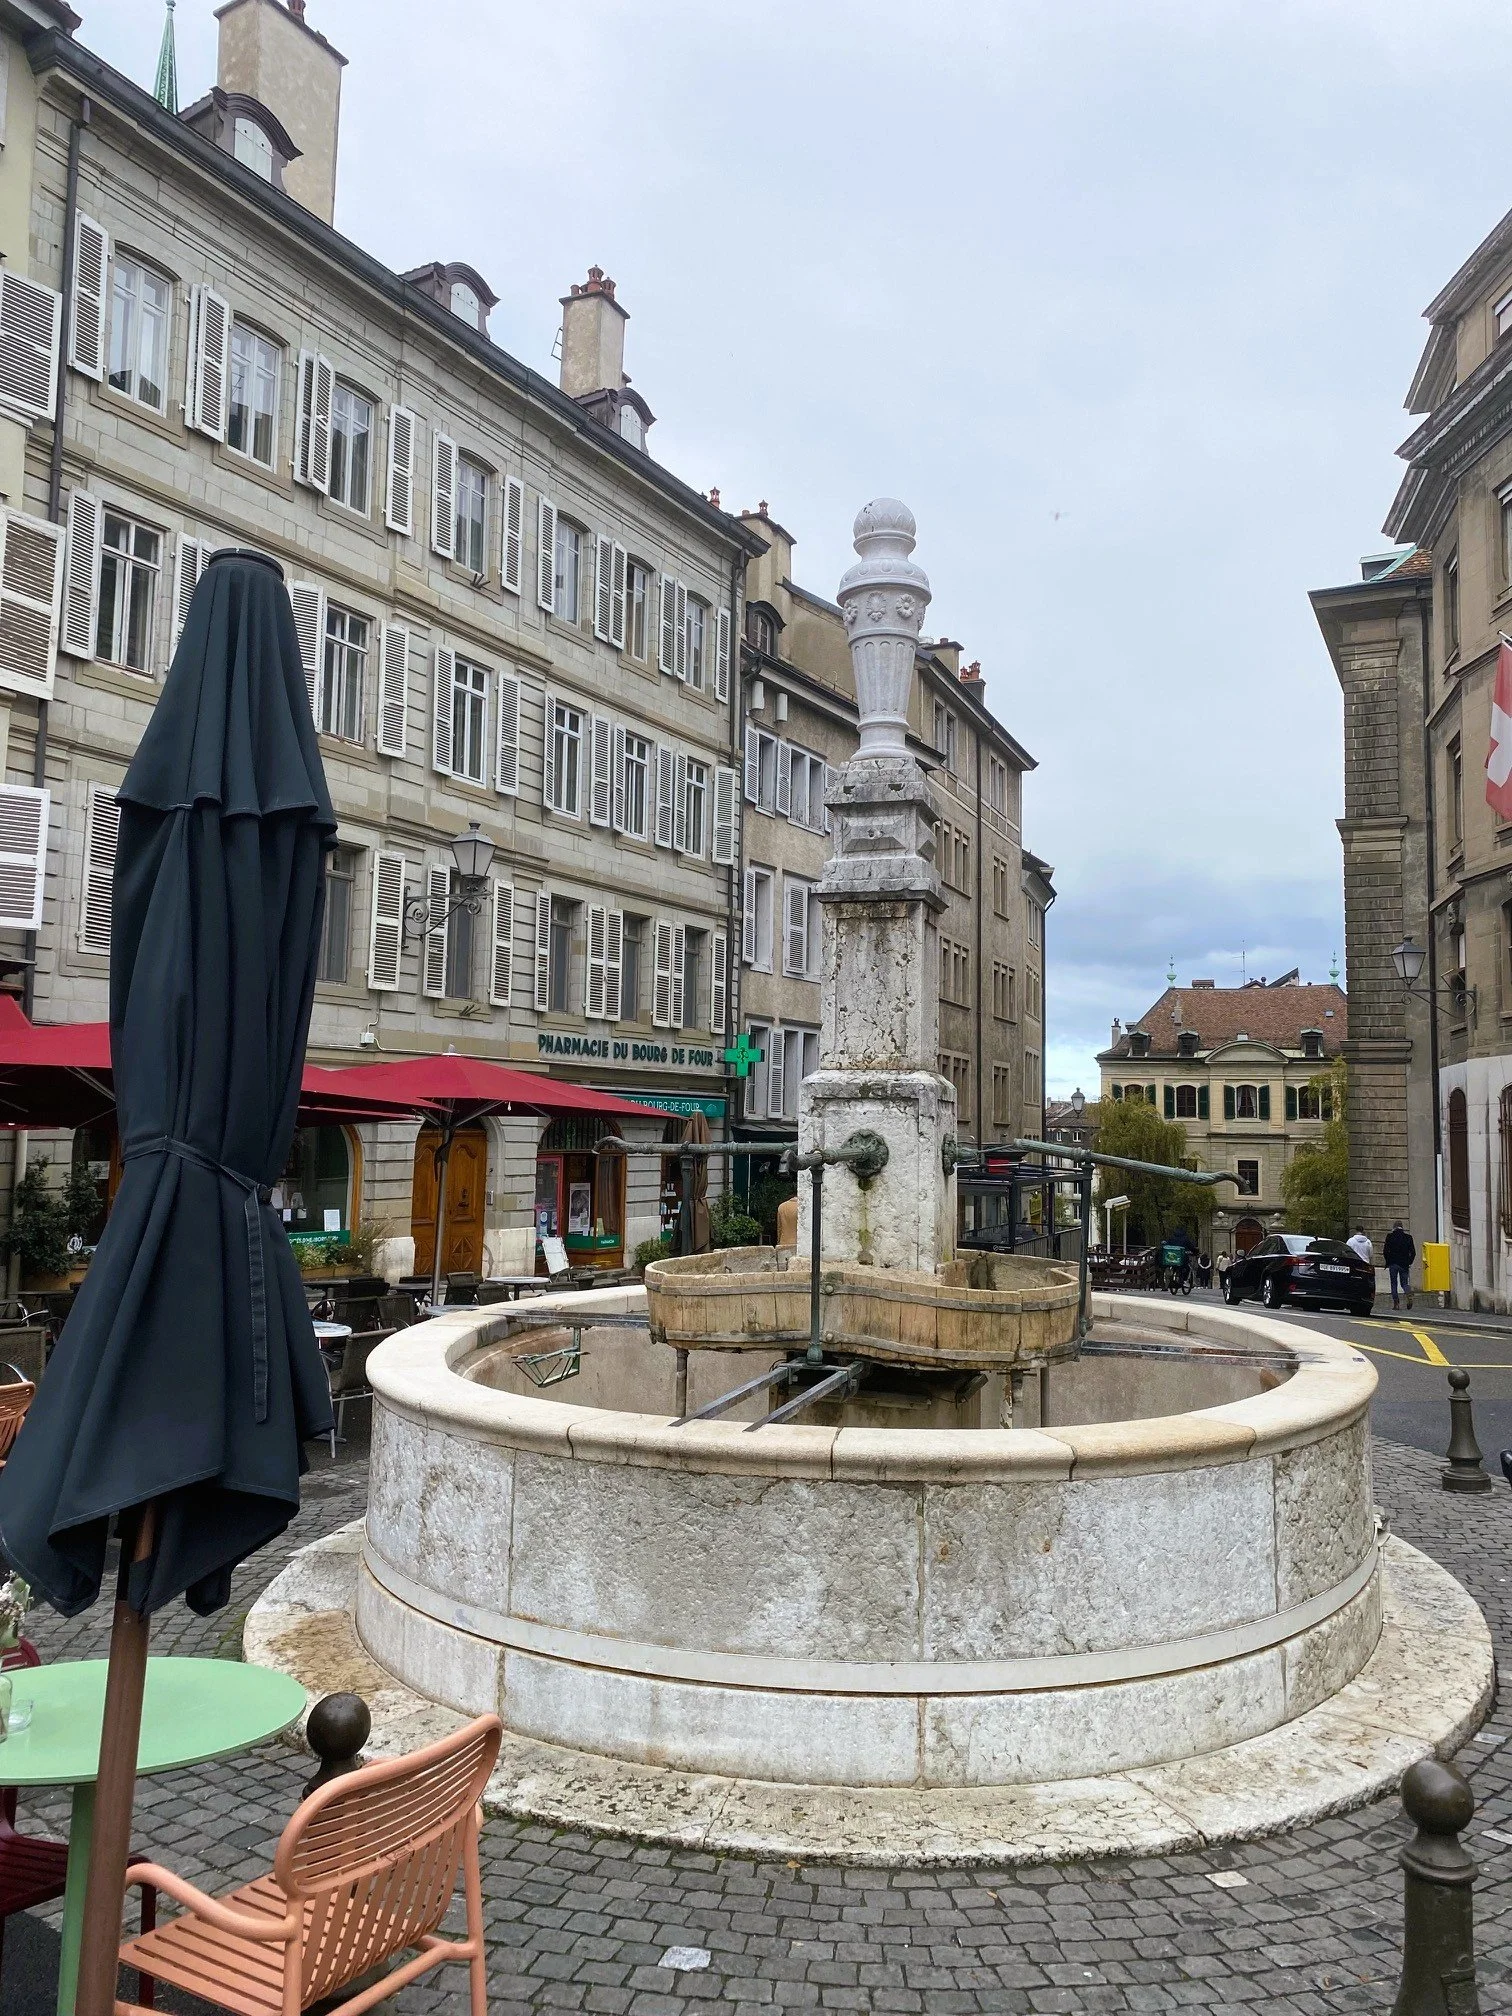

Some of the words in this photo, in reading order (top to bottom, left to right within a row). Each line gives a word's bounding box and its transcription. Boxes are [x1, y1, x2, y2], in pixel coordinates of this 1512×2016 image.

[538, 1034, 609, 1058] PHARMACIE
[613, 1042, 628, 1060] DU
[632, 1044, 668, 1063] BOURG
[671, 1048, 685, 1064] DE
[688, 1049, 713, 1067] FOUR
